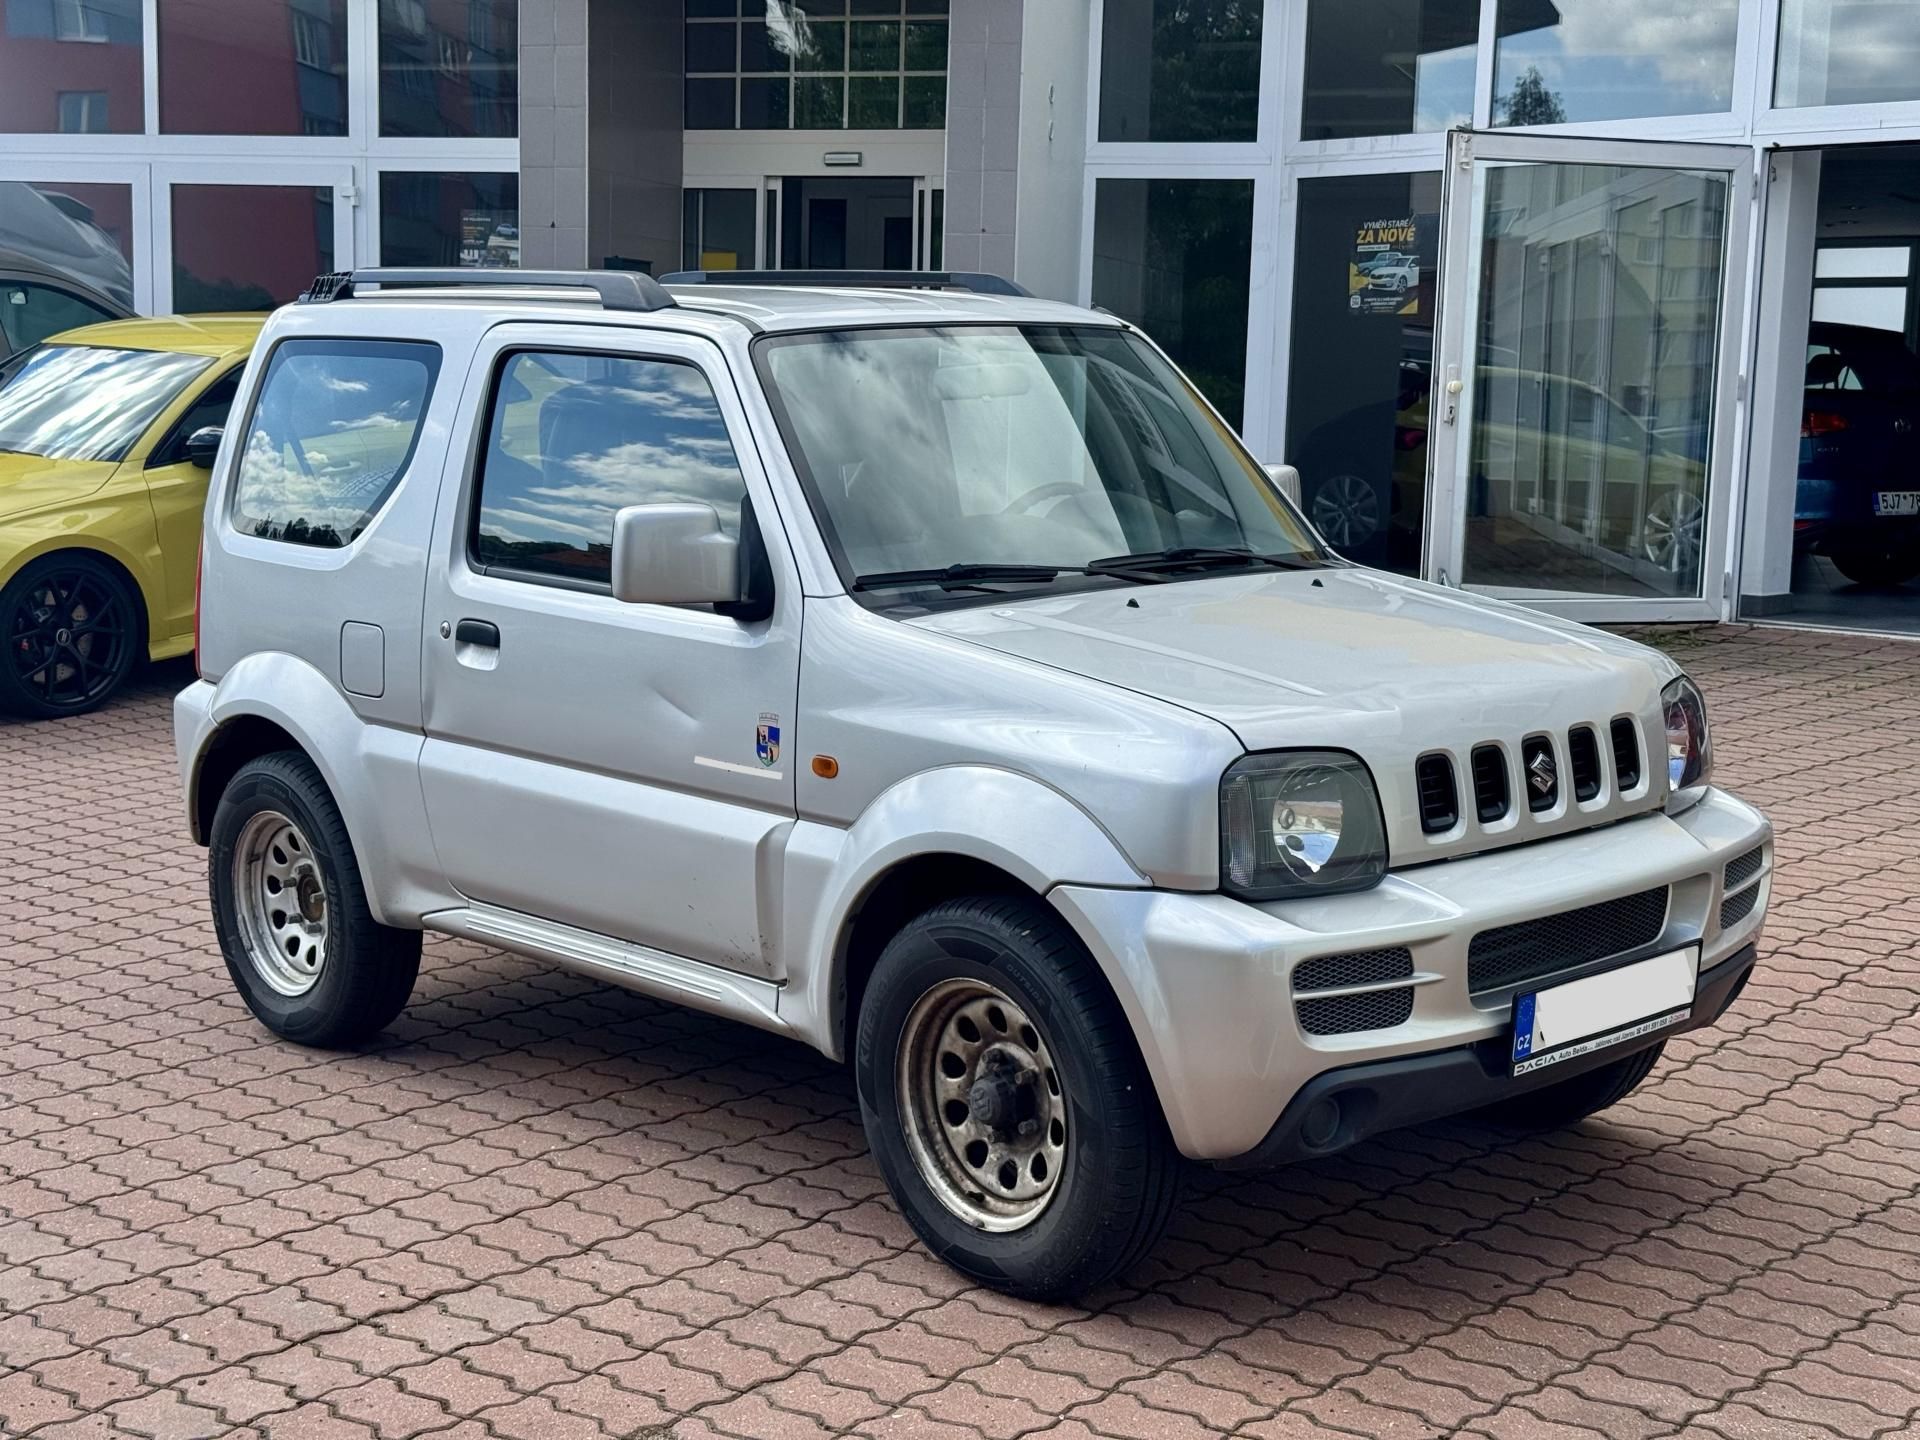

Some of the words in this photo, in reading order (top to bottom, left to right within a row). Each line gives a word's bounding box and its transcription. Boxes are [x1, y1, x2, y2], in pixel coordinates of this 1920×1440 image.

[1363, 219, 1387, 229] VYMĚŇ
[1388, 219, 1409, 229] STARÉ
[1356, 230, 1374, 244] ZA
[1377, 224, 1416, 243] NOVÉ
[1517, 1034, 1531, 1050] CZ
[1516, 1055, 1556, 1074] DACIA
[1558, 1051, 1572, 1060] Auto
